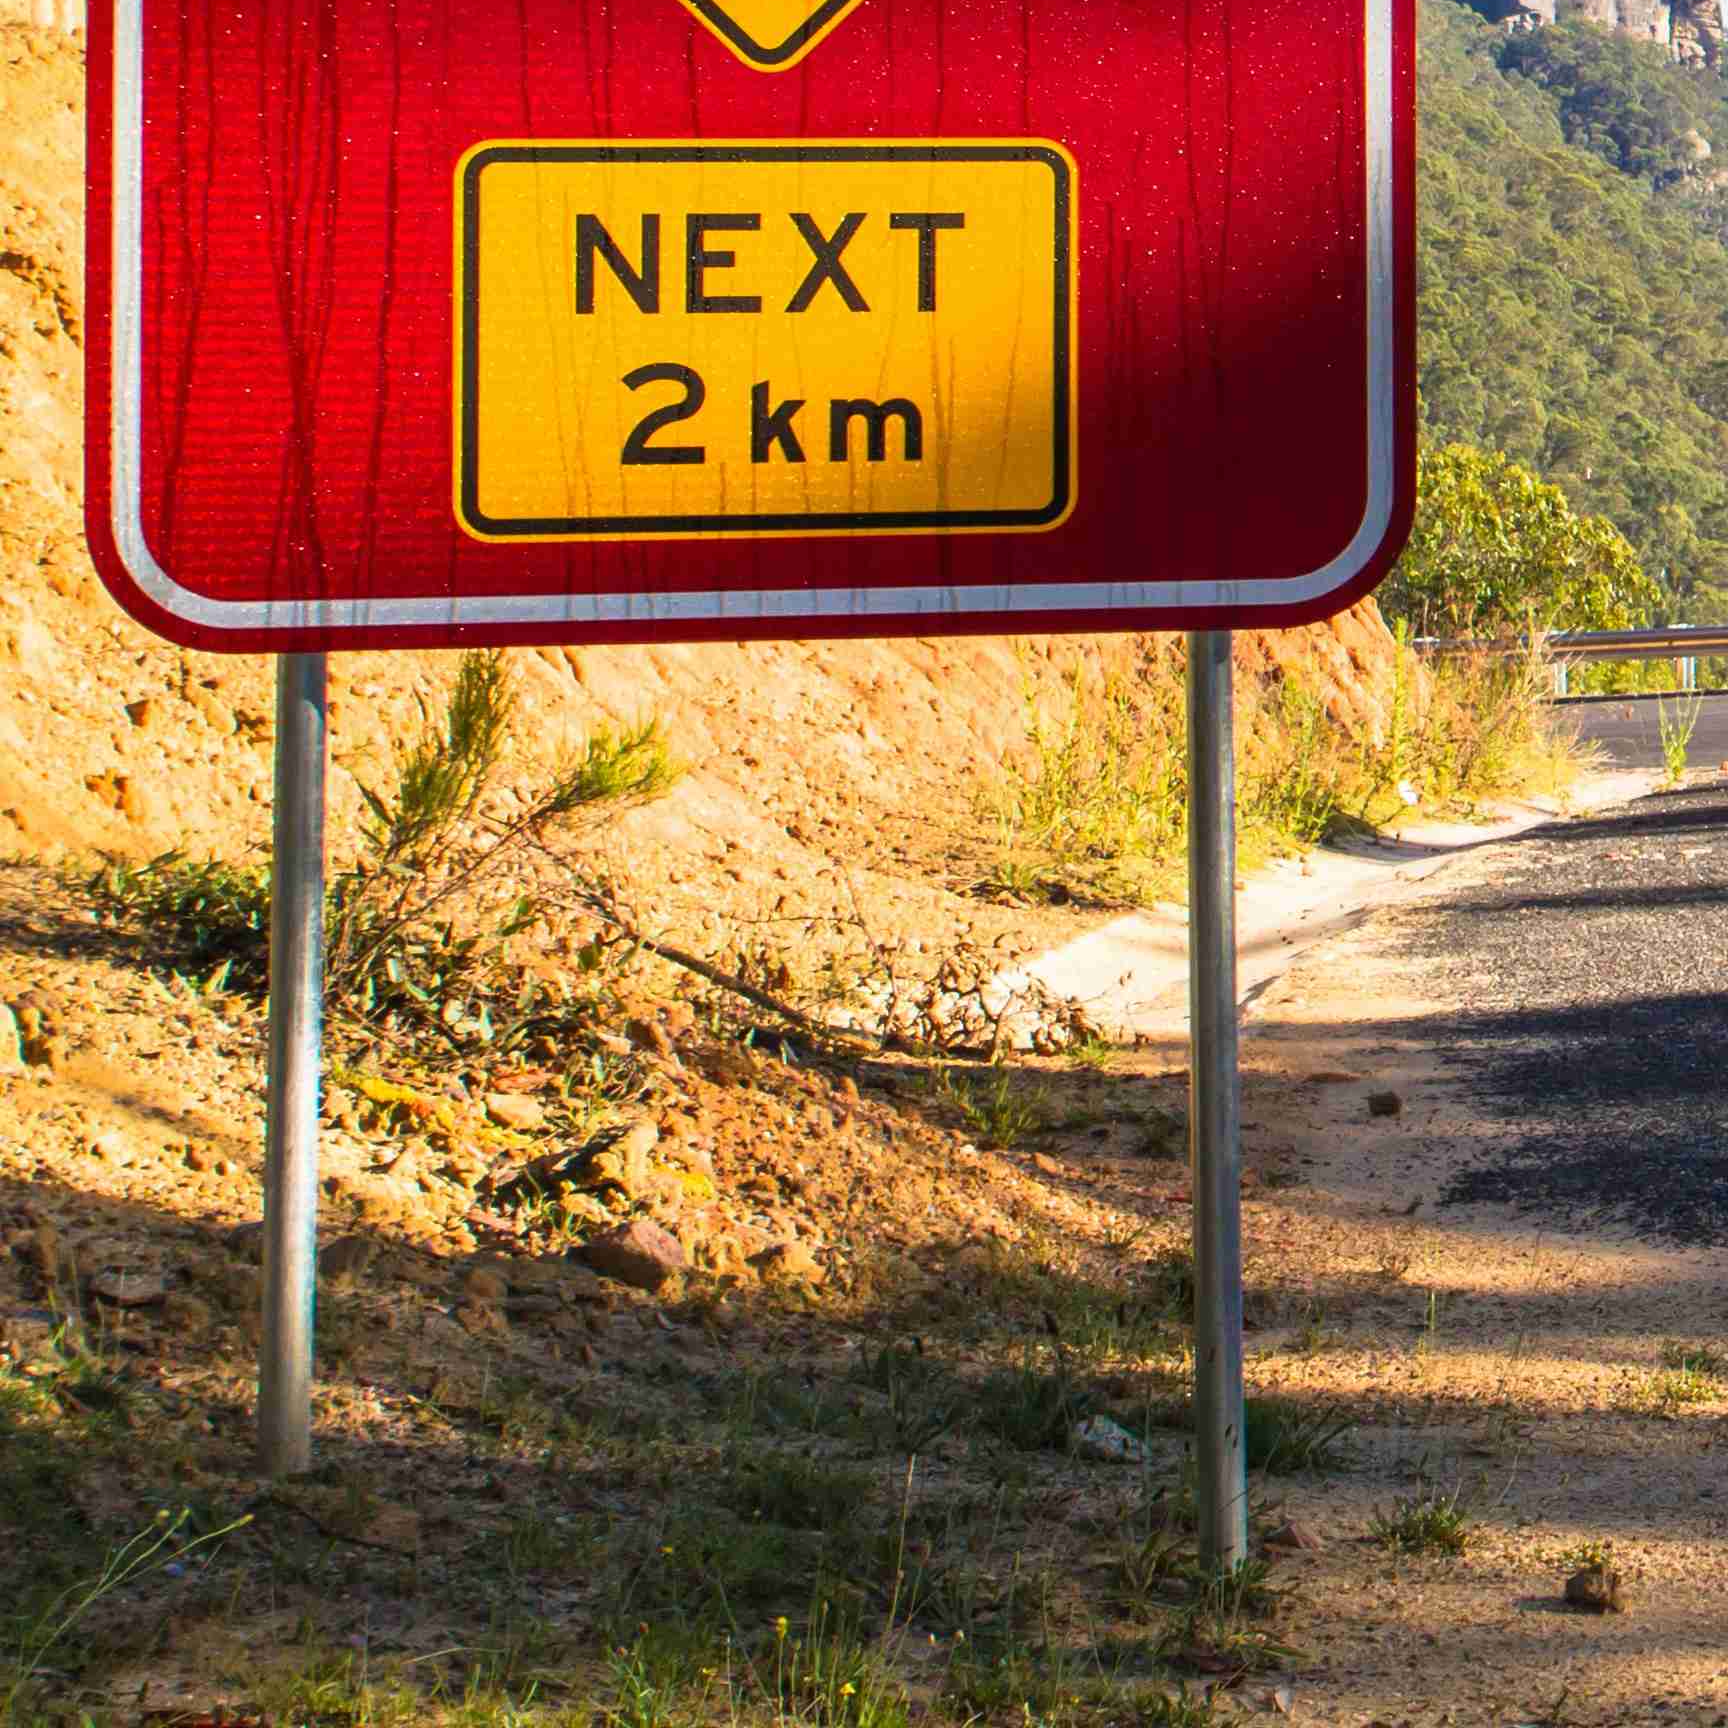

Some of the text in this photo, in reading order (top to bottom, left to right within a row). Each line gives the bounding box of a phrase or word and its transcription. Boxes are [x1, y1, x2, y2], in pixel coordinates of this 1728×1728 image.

[575, 212, 964, 314] NEXT
[620, 362, 923, 466] 2 km
